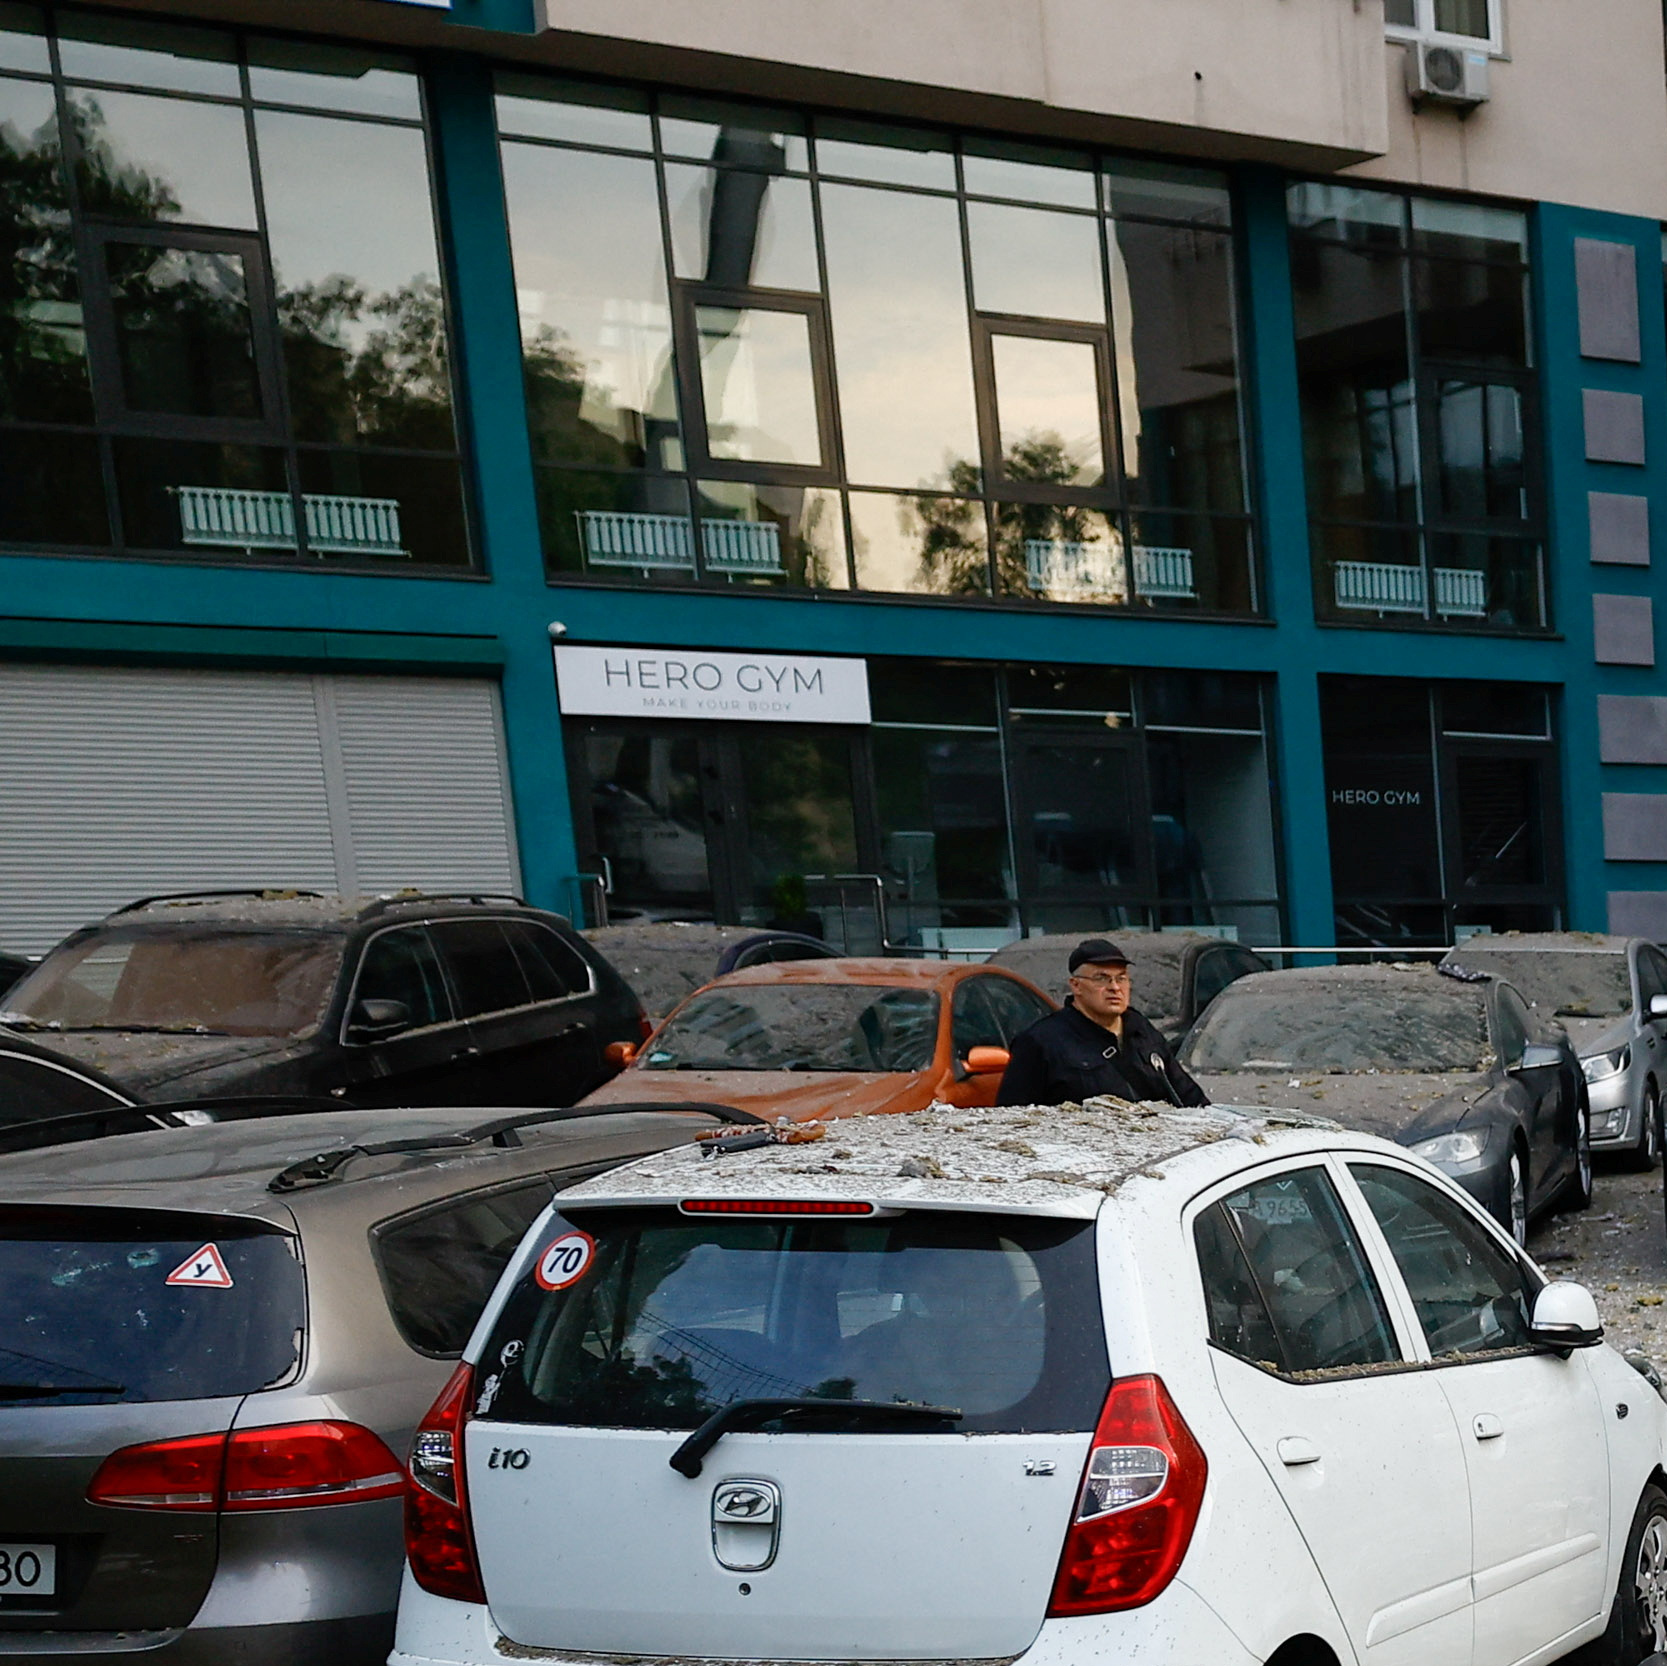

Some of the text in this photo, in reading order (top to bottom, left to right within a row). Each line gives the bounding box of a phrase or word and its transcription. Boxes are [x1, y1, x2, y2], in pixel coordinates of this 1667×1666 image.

[604, 659, 823, 695] HERO GYM
[642, 698, 792, 712] MAKE YOUR BODY
[1332, 790, 1420, 805] HERO GYM
[547, 1246, 584, 1274] 70
[488, 1446, 531, 1470] i10
[1022, 1459, 1057, 1477] 1.2
